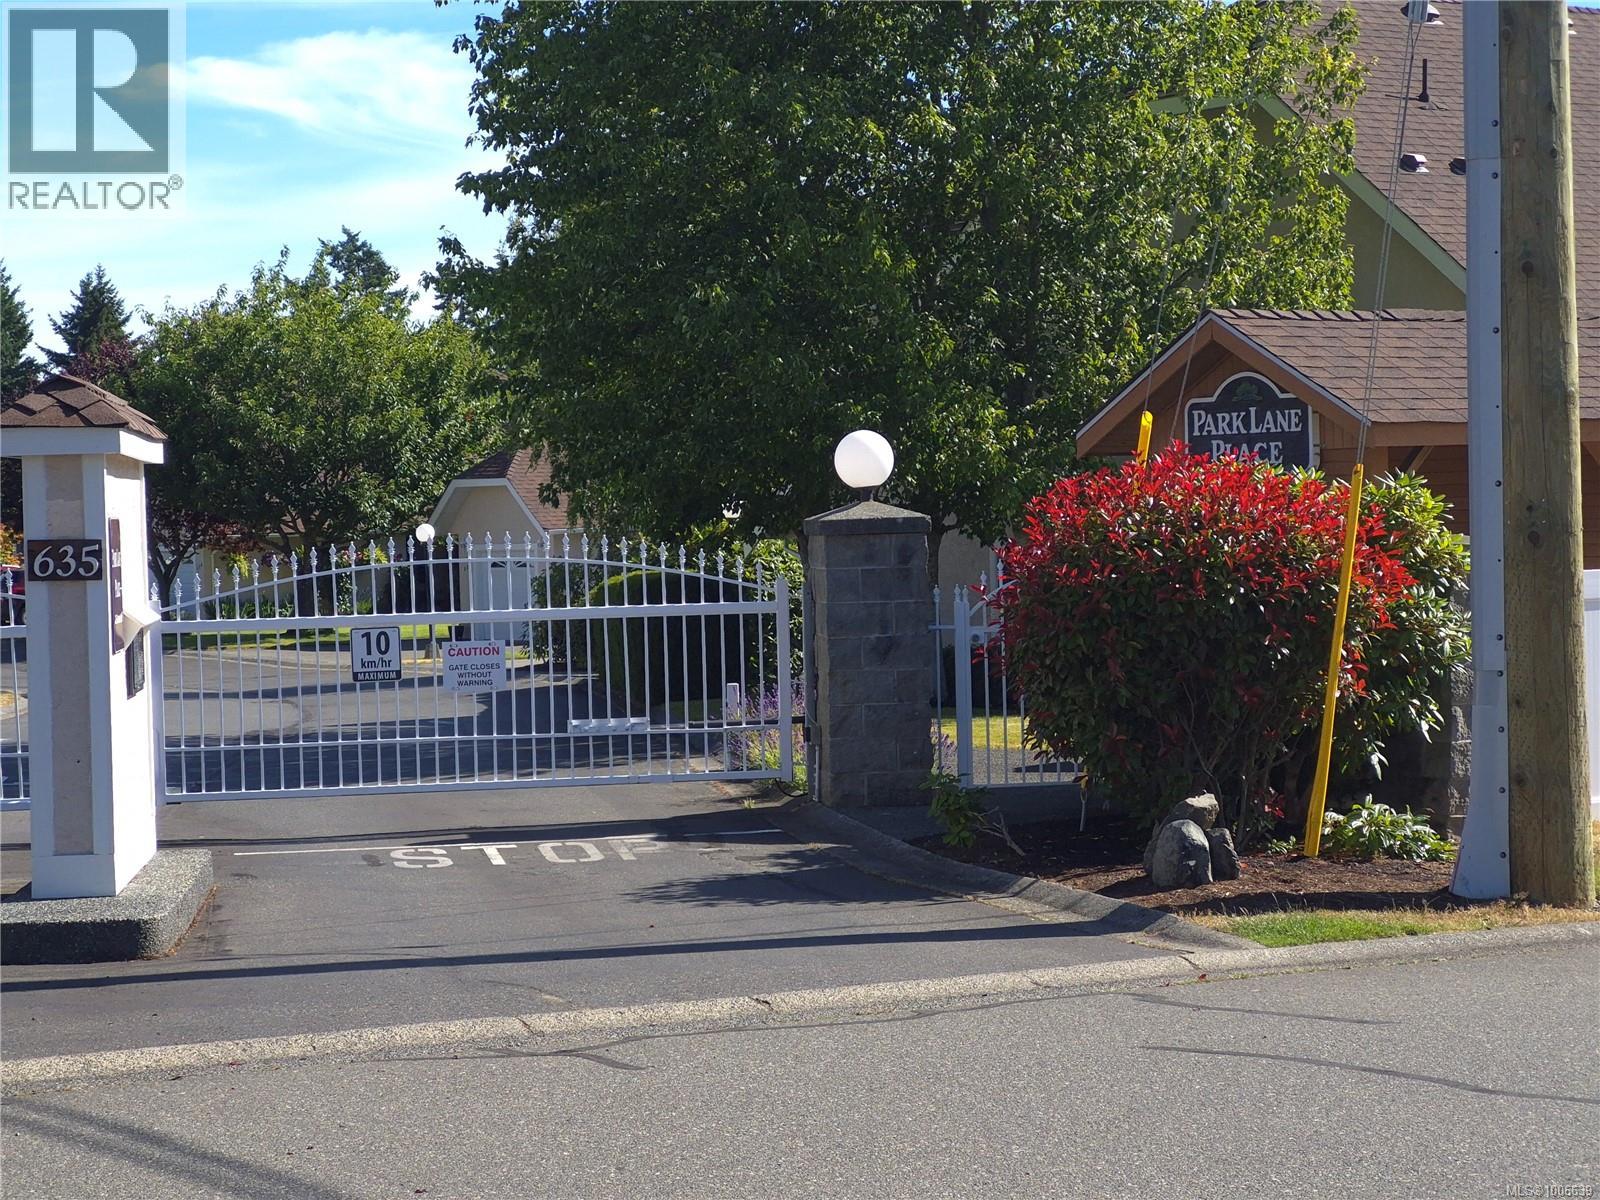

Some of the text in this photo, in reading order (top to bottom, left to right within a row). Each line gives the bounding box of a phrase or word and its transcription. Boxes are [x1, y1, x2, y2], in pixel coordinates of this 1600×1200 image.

[33, 544, 100, 577] 635
[361, 630, 391, 656] 10
[447, 646, 500, 657] CAUTION
[360, 657, 393, 670] km/hr
[470, 662, 501, 670] CLOSES
[357, 671, 397, 681] MAXIMUM
[457, 671, 492, 679] WITHOUT
[457, 679, 494, 687] WARNING
[389, 837, 670, 869] STOP
